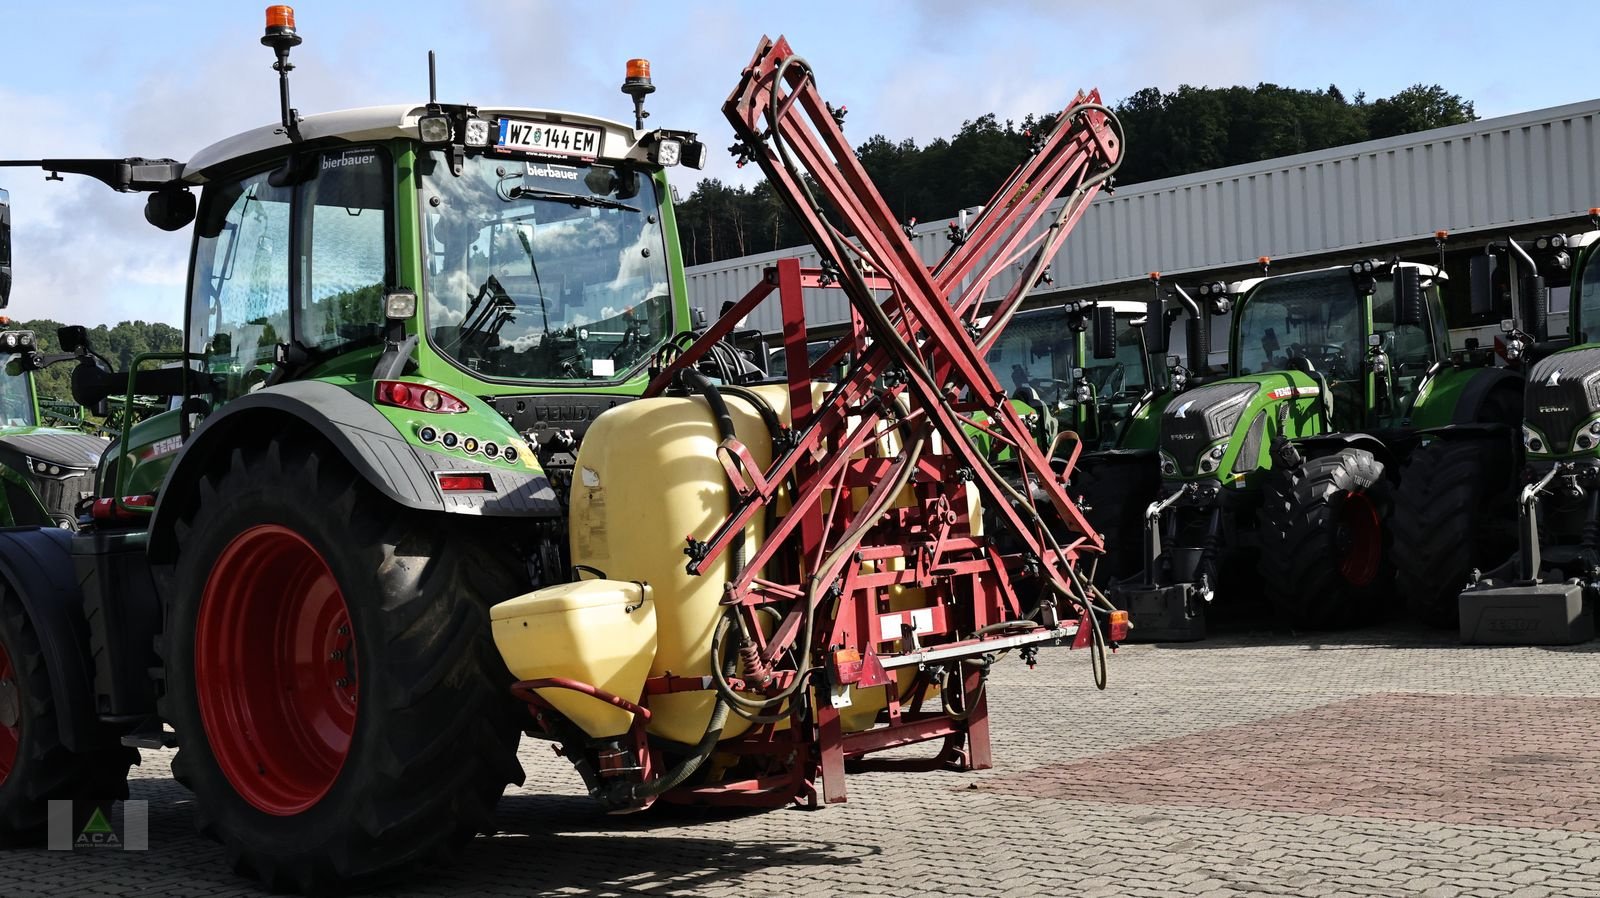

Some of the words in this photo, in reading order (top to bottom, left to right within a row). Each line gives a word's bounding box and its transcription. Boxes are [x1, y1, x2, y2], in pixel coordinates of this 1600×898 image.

[509, 123, 533, 146] WZ
[544, 127, 570, 150] 144
[573, 131, 595, 152] EM
[322, 151, 375, 169] bierbauer
[526, 161, 578, 180] bierbauer
[152, 435, 183, 456] FEND
